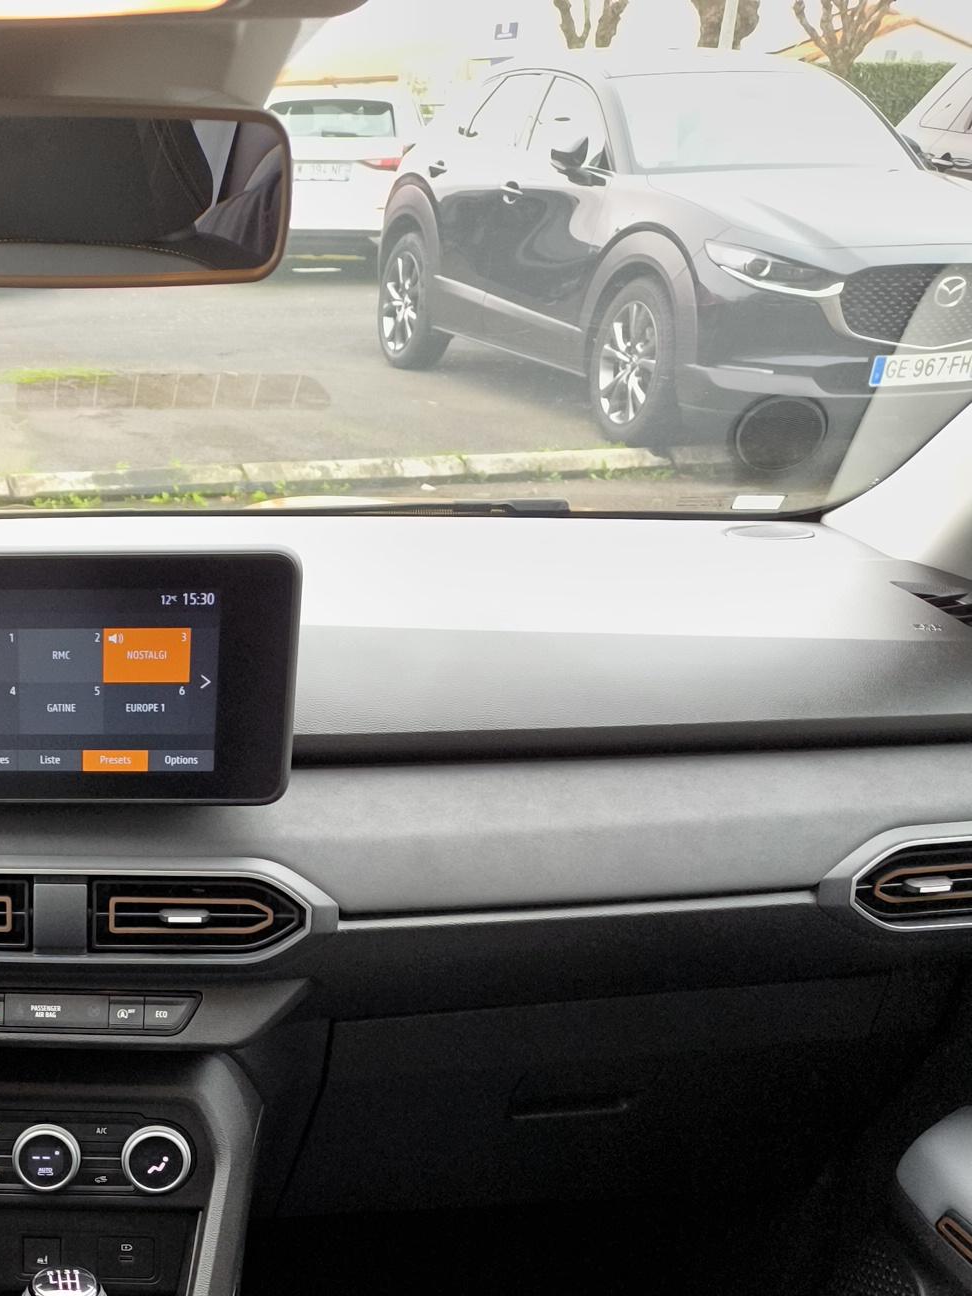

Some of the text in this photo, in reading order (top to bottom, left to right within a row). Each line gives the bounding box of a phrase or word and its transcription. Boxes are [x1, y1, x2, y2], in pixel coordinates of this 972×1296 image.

[182, 592, 215, 606] 15:30
[9, 633, 15, 643] 1
[94, 633, 101, 643] 2
[181, 633, 187, 642] 3
[52, 650, 71, 660] RMC
[127, 650, 167, 660] NOSTALGI
[9, 686, 16, 696] 4
[94, 686, 100, 696] 5
[179, 686, 186, 696] 6
[46, 703, 77, 713] GATINE
[125, 703, 166, 713] EUROPE 1
[40, 755, 61, 765] Liste
[99, 755, 132, 765] Presets
[164, 755, 198, 767] Options
[155, 1010, 168, 1018] ECO
[96, 1127, 108, 1135] A/C
